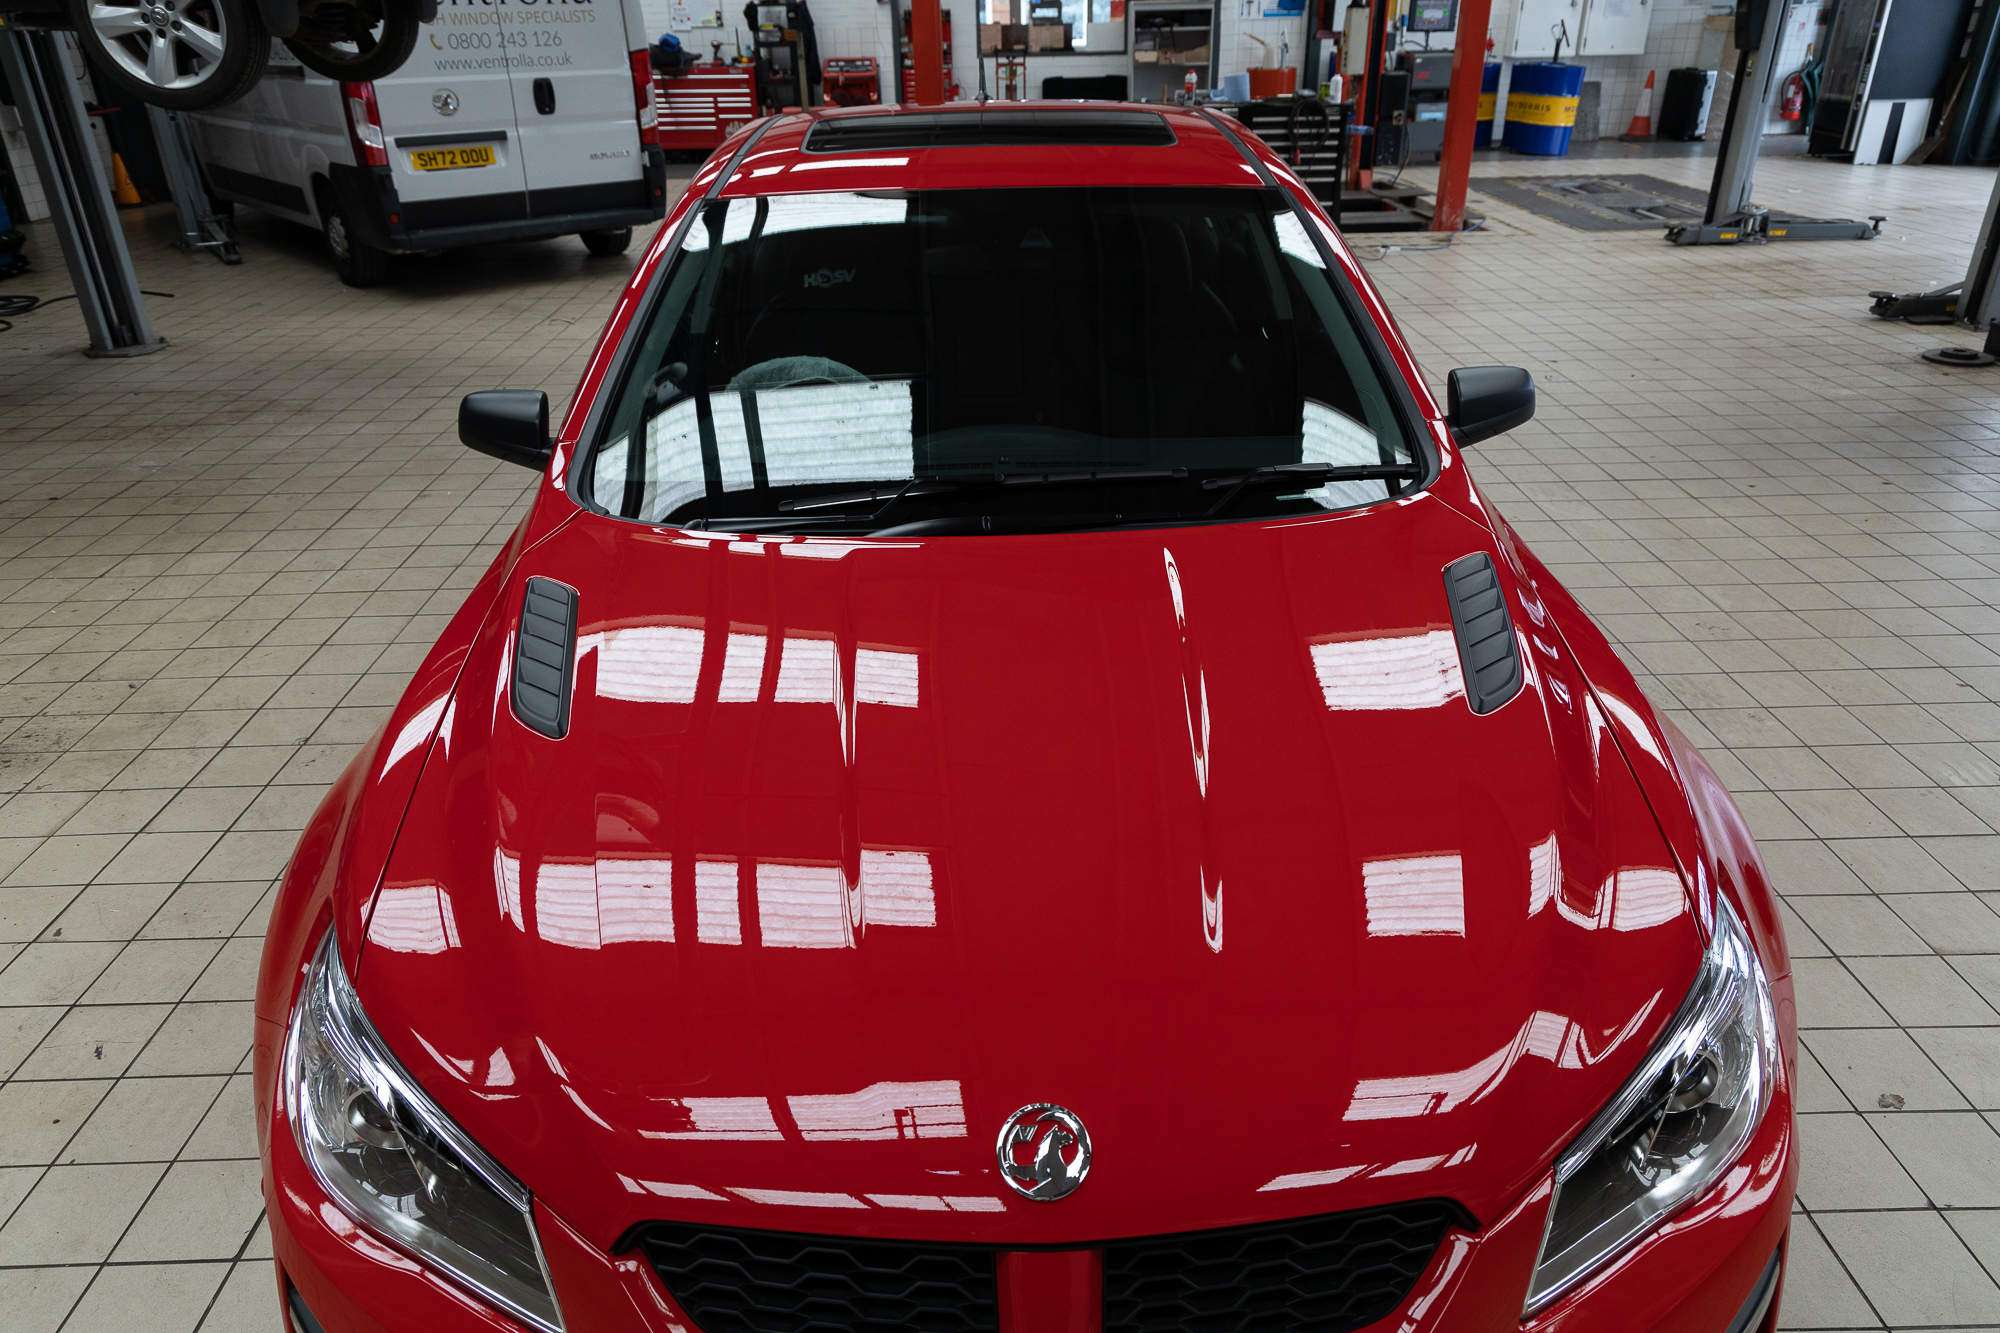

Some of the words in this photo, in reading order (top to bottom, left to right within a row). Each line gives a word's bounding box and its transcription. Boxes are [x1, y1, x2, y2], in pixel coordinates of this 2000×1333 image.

[448, 11, 514, 26] WINDOW
[517, 9, 596, 25] SPECIALISTS
[447, 32, 492, 50] 0800
[496, 31, 528, 48] 243
[532, 30, 563, 47] 126
[434, 52, 573, 71] www.ventrolla.co.uk
[417, 150, 458, 167] SH72
